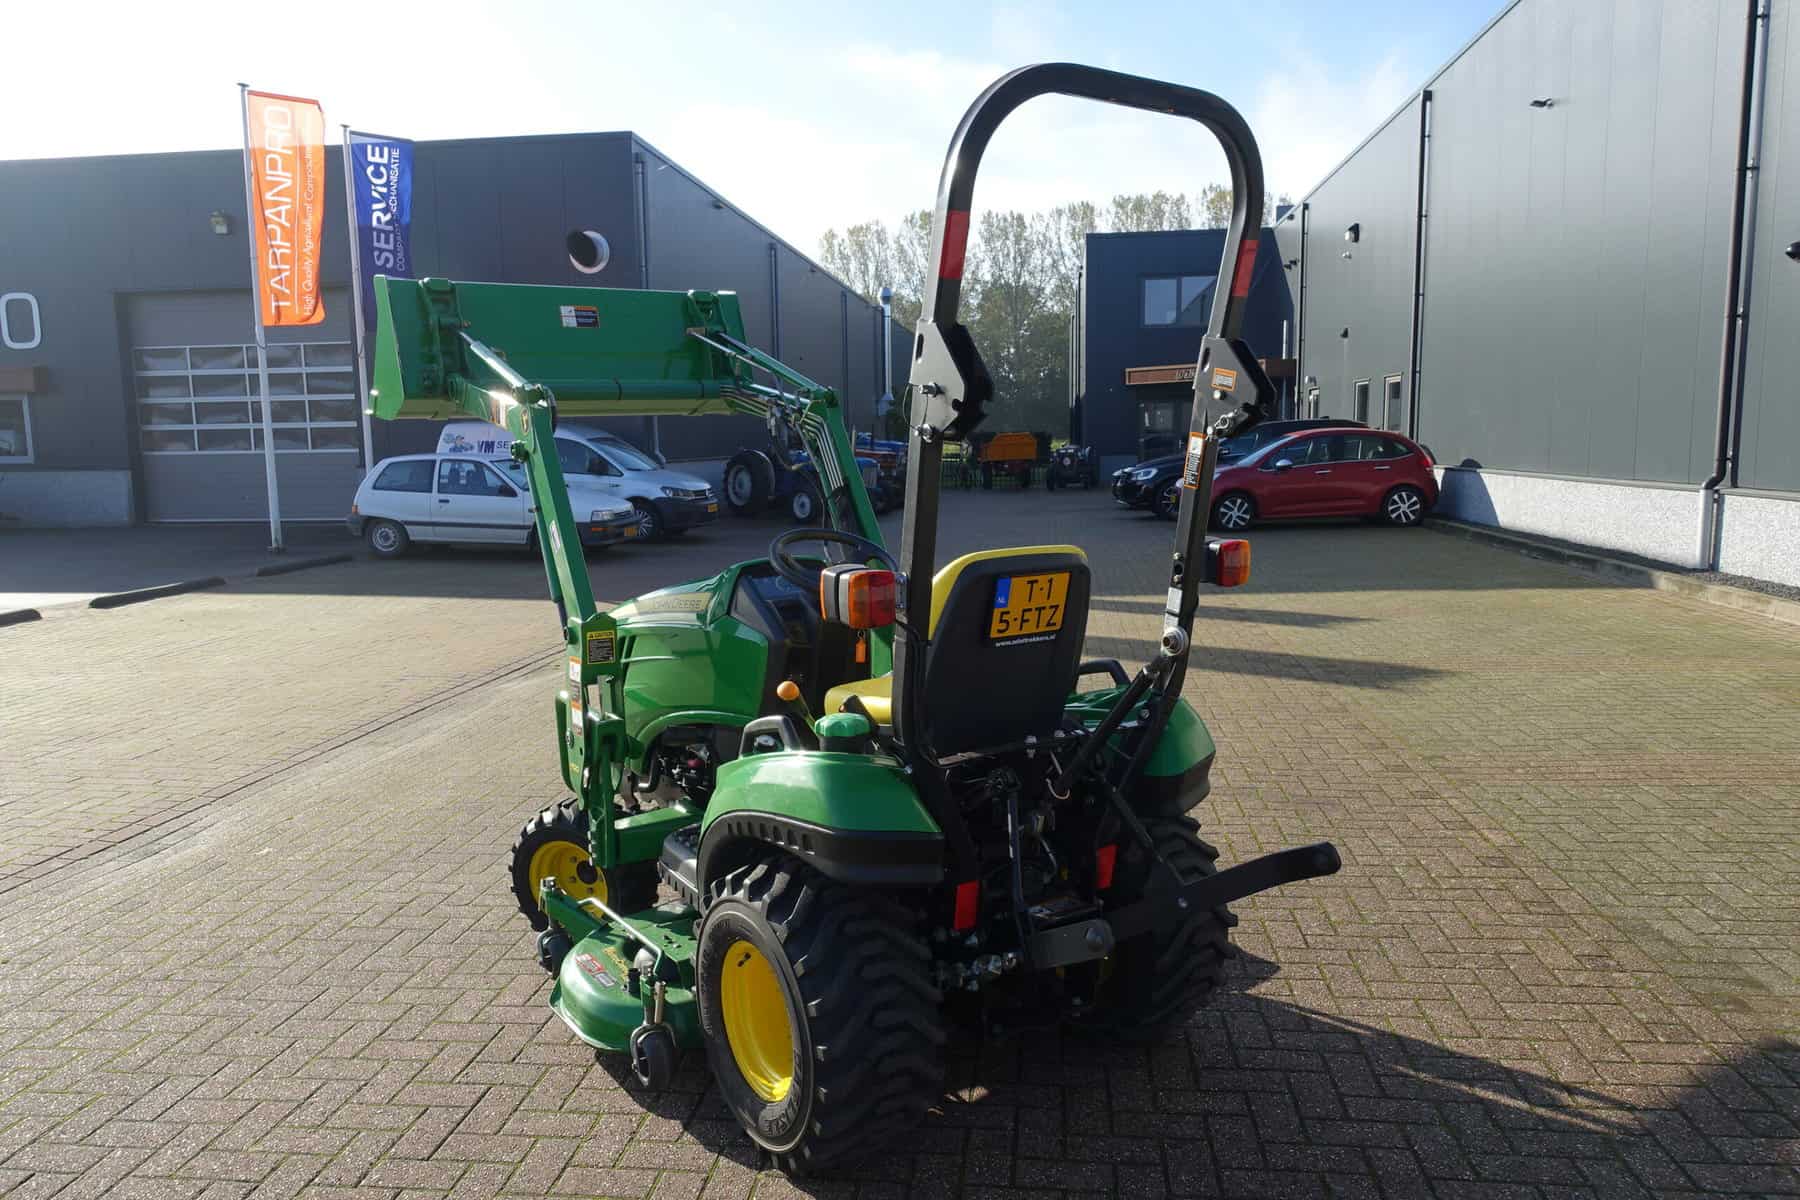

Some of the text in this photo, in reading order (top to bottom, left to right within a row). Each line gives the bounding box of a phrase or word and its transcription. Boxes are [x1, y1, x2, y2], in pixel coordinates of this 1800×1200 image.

[388, 147, 400, 219] ECHANISATIE
[264, 105, 292, 314] TARPANPRO
[302, 257, 313, 292] Quality
[303, 296, 315, 316] High
[477, 440, 496, 454] VM
